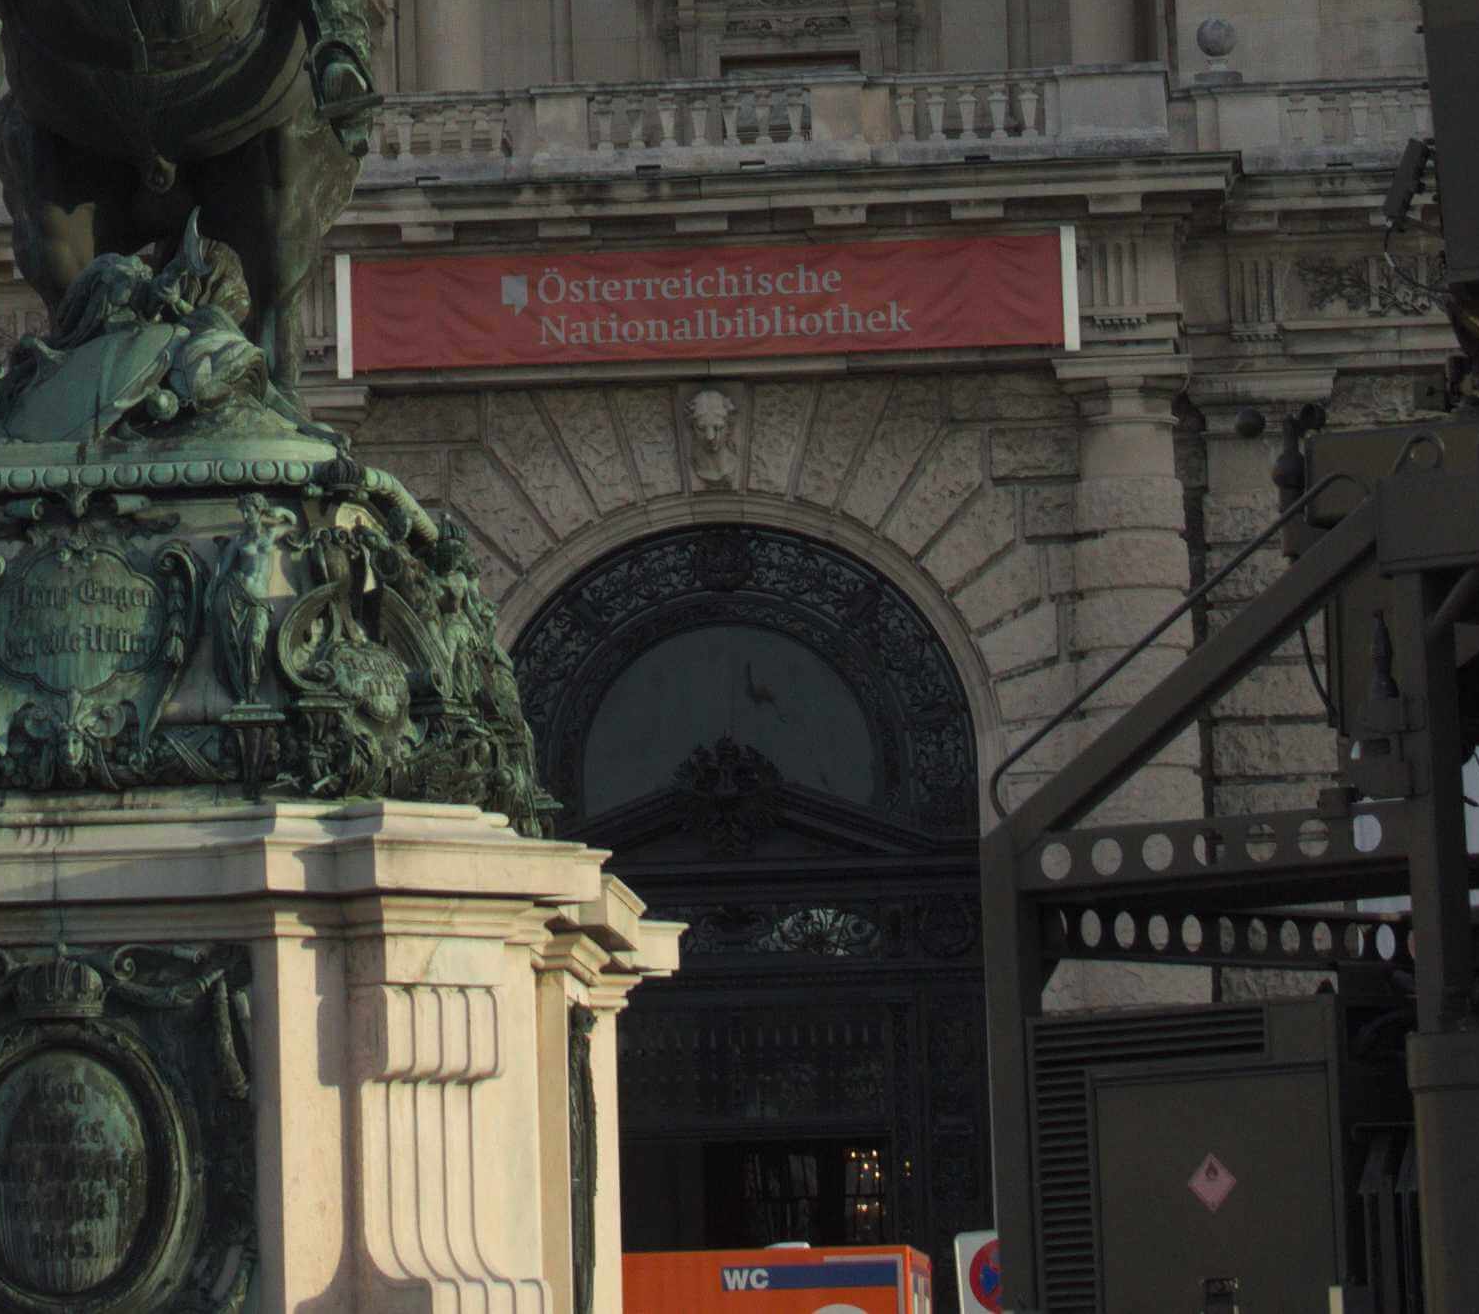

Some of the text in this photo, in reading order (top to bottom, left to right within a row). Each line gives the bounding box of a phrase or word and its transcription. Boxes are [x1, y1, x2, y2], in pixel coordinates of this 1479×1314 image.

[537, 263, 843, 305] Österreichische
[539, 300, 912, 346] Nationalbibliothek
[723, 1268, 770, 1290] WC
